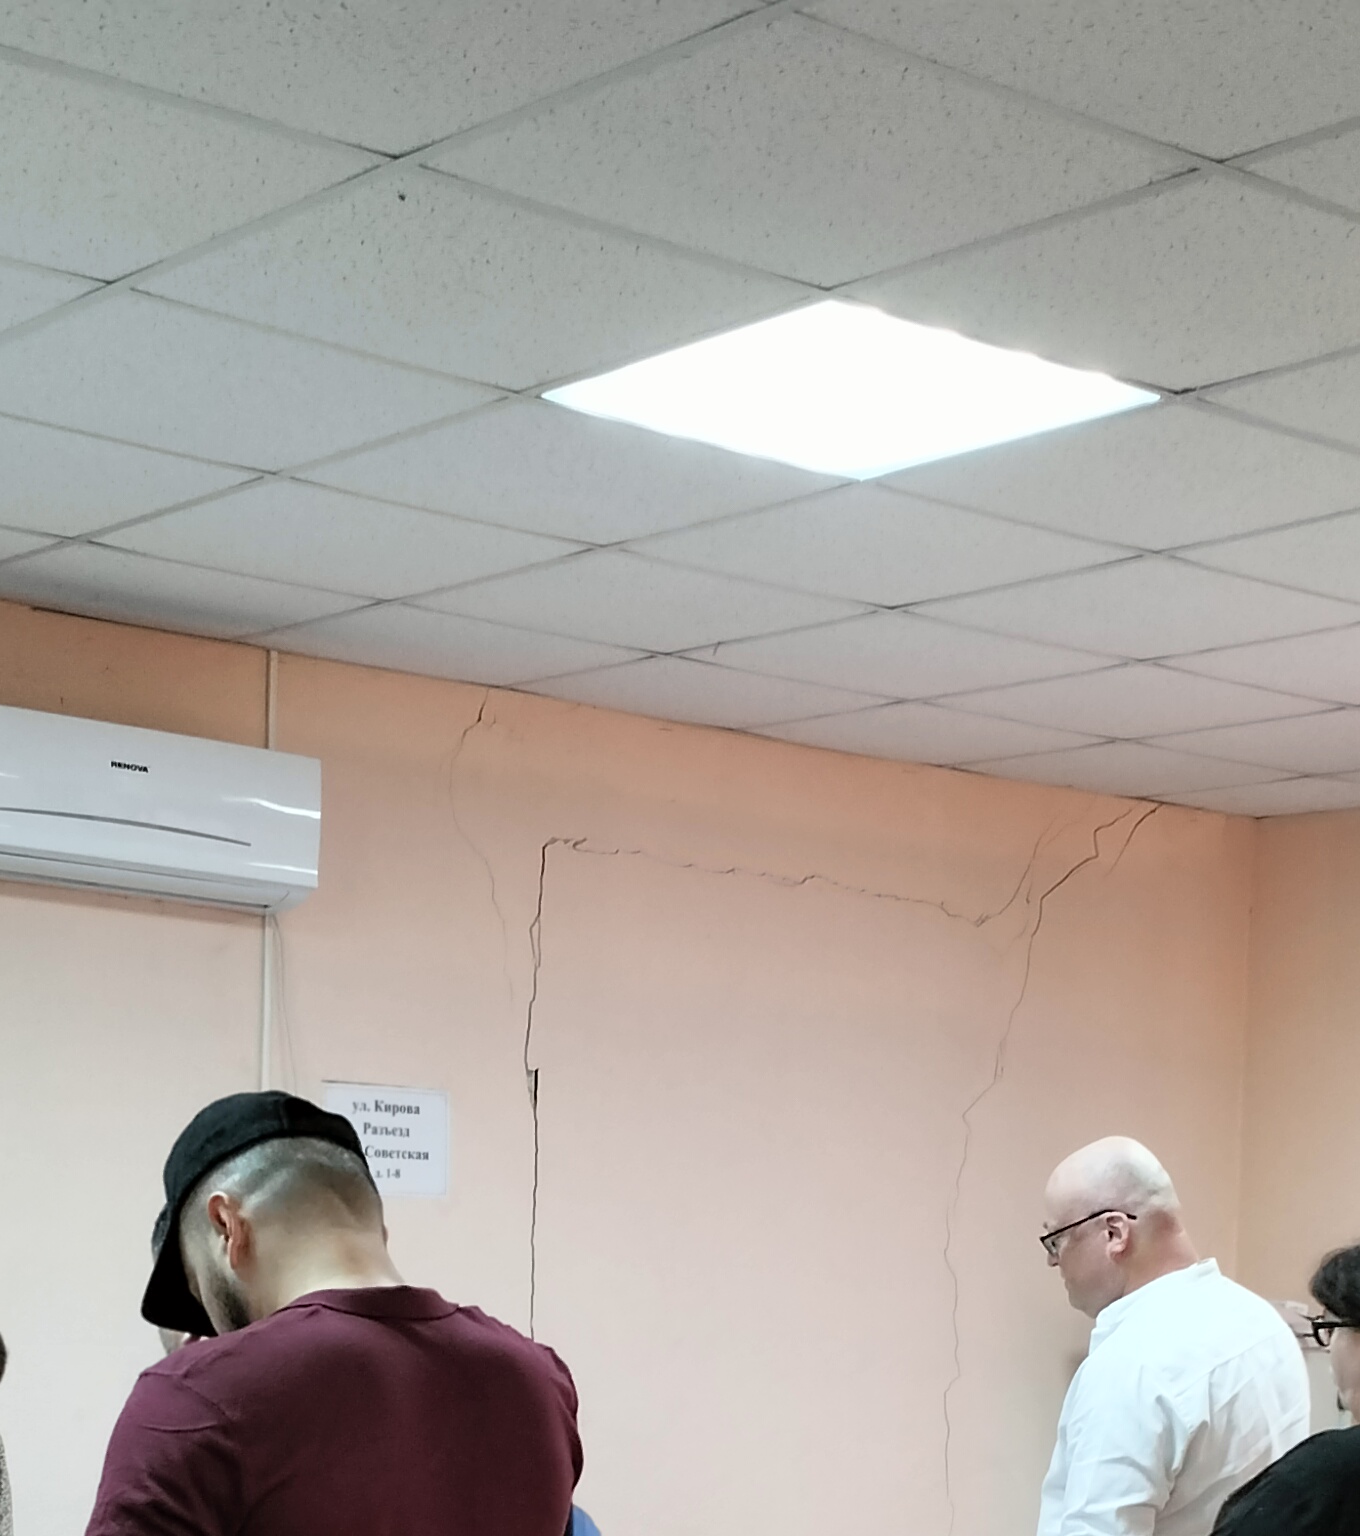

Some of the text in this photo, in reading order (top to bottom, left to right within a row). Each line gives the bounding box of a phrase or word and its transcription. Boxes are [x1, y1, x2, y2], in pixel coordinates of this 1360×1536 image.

[110, 761, 149, 773] RENOVA
[352, 1100, 420, 1117] ул. Кирова
[363, 1122, 410, 1138] Разъезд
[364, 1145, 429, 1161] Советская
